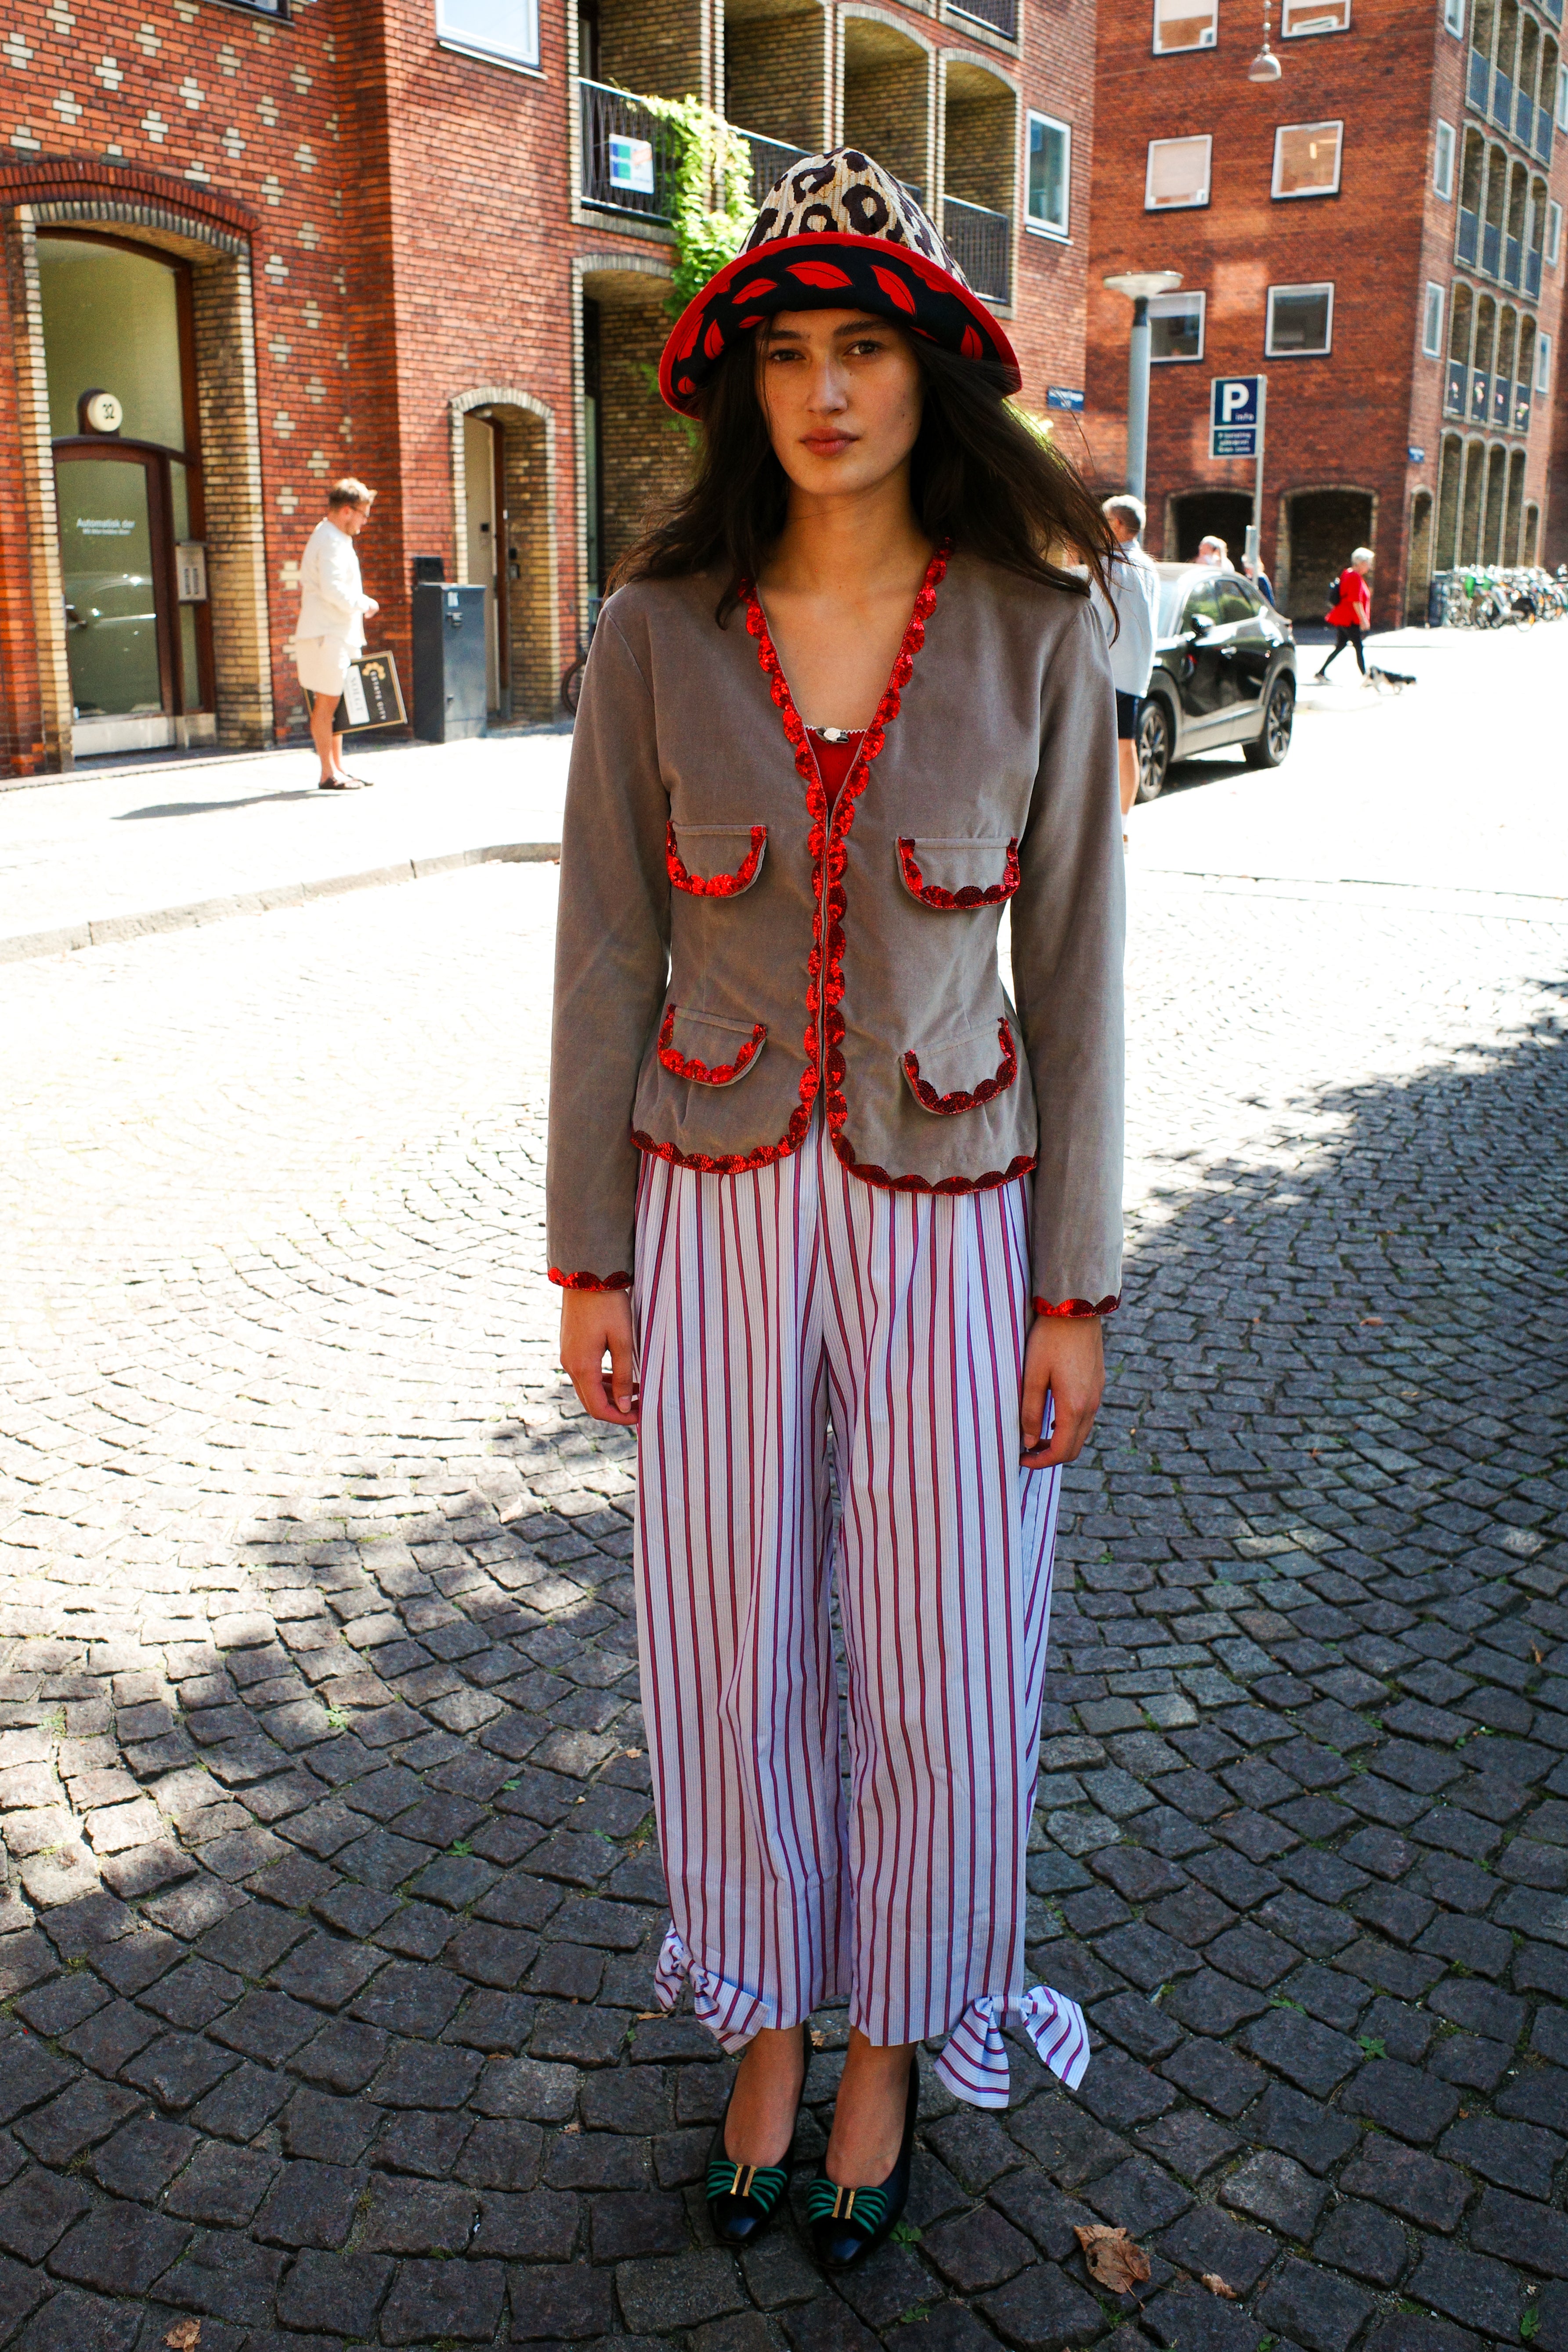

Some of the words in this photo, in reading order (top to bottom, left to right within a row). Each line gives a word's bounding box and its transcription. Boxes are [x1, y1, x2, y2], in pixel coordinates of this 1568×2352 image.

[102, 403, 115, 419] 32
[1222, 383, 1250, 423] P
[1235, 412, 1255, 422] info
[370, 671, 383, 700] ESTATE
[376, 701, 387, 720] CITY
